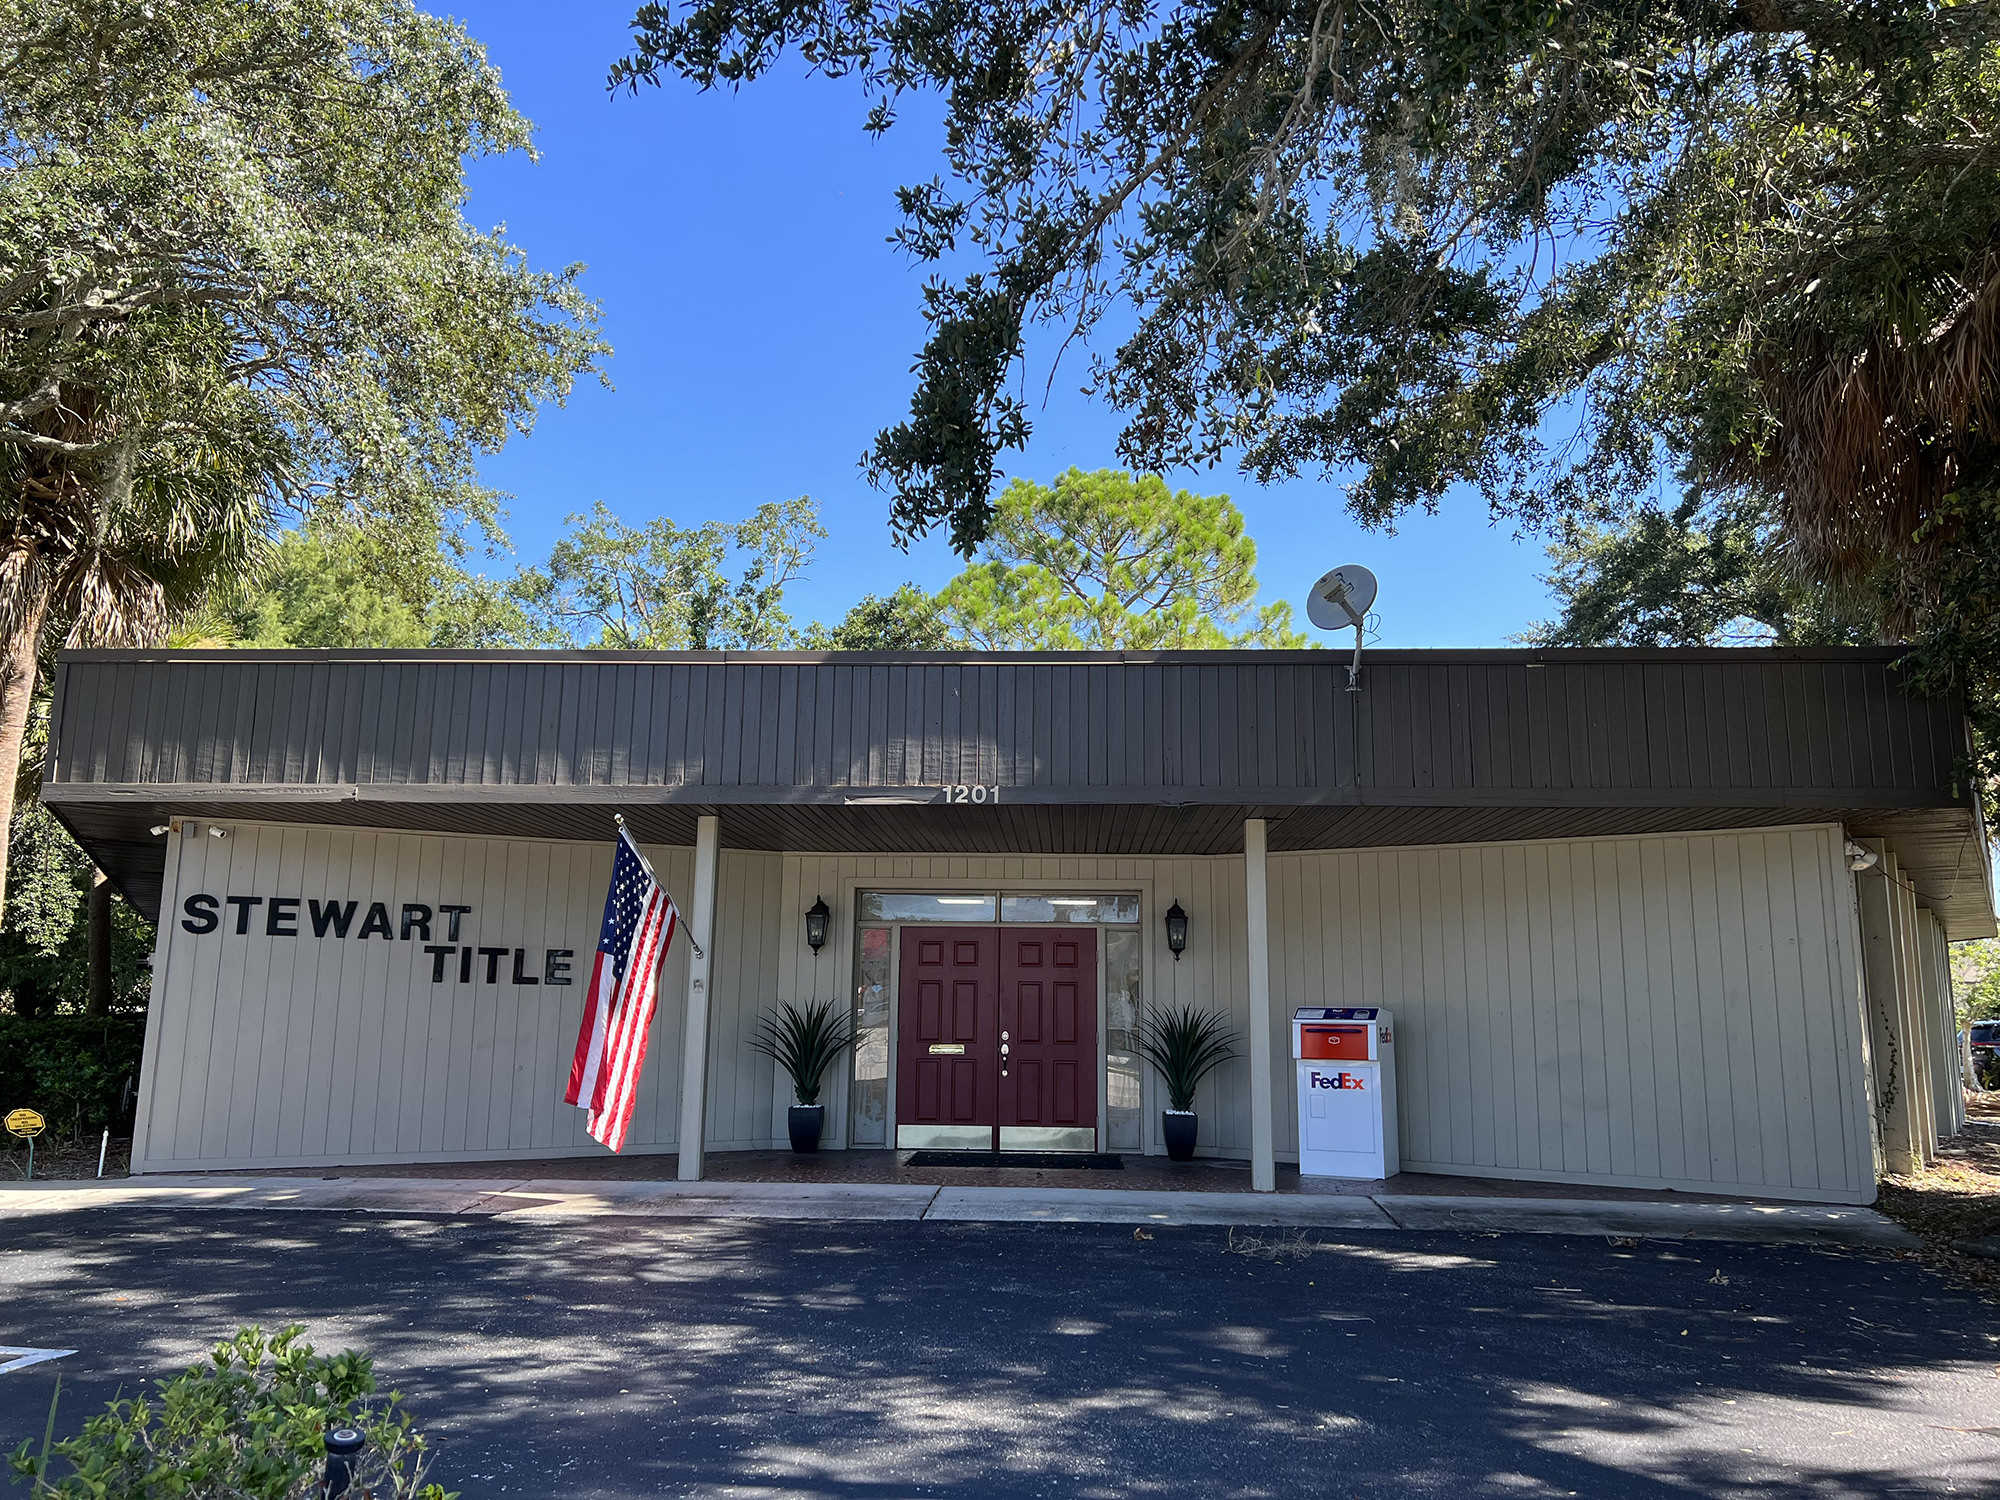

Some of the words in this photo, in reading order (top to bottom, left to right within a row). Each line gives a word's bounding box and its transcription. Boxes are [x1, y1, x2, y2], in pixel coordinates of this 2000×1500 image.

[942, 785, 999, 804] 1201
[181, 894, 471, 942] STEWART
[424, 945, 574, 986] TITLE
[1311, 1071, 1365, 1090] FedEx
